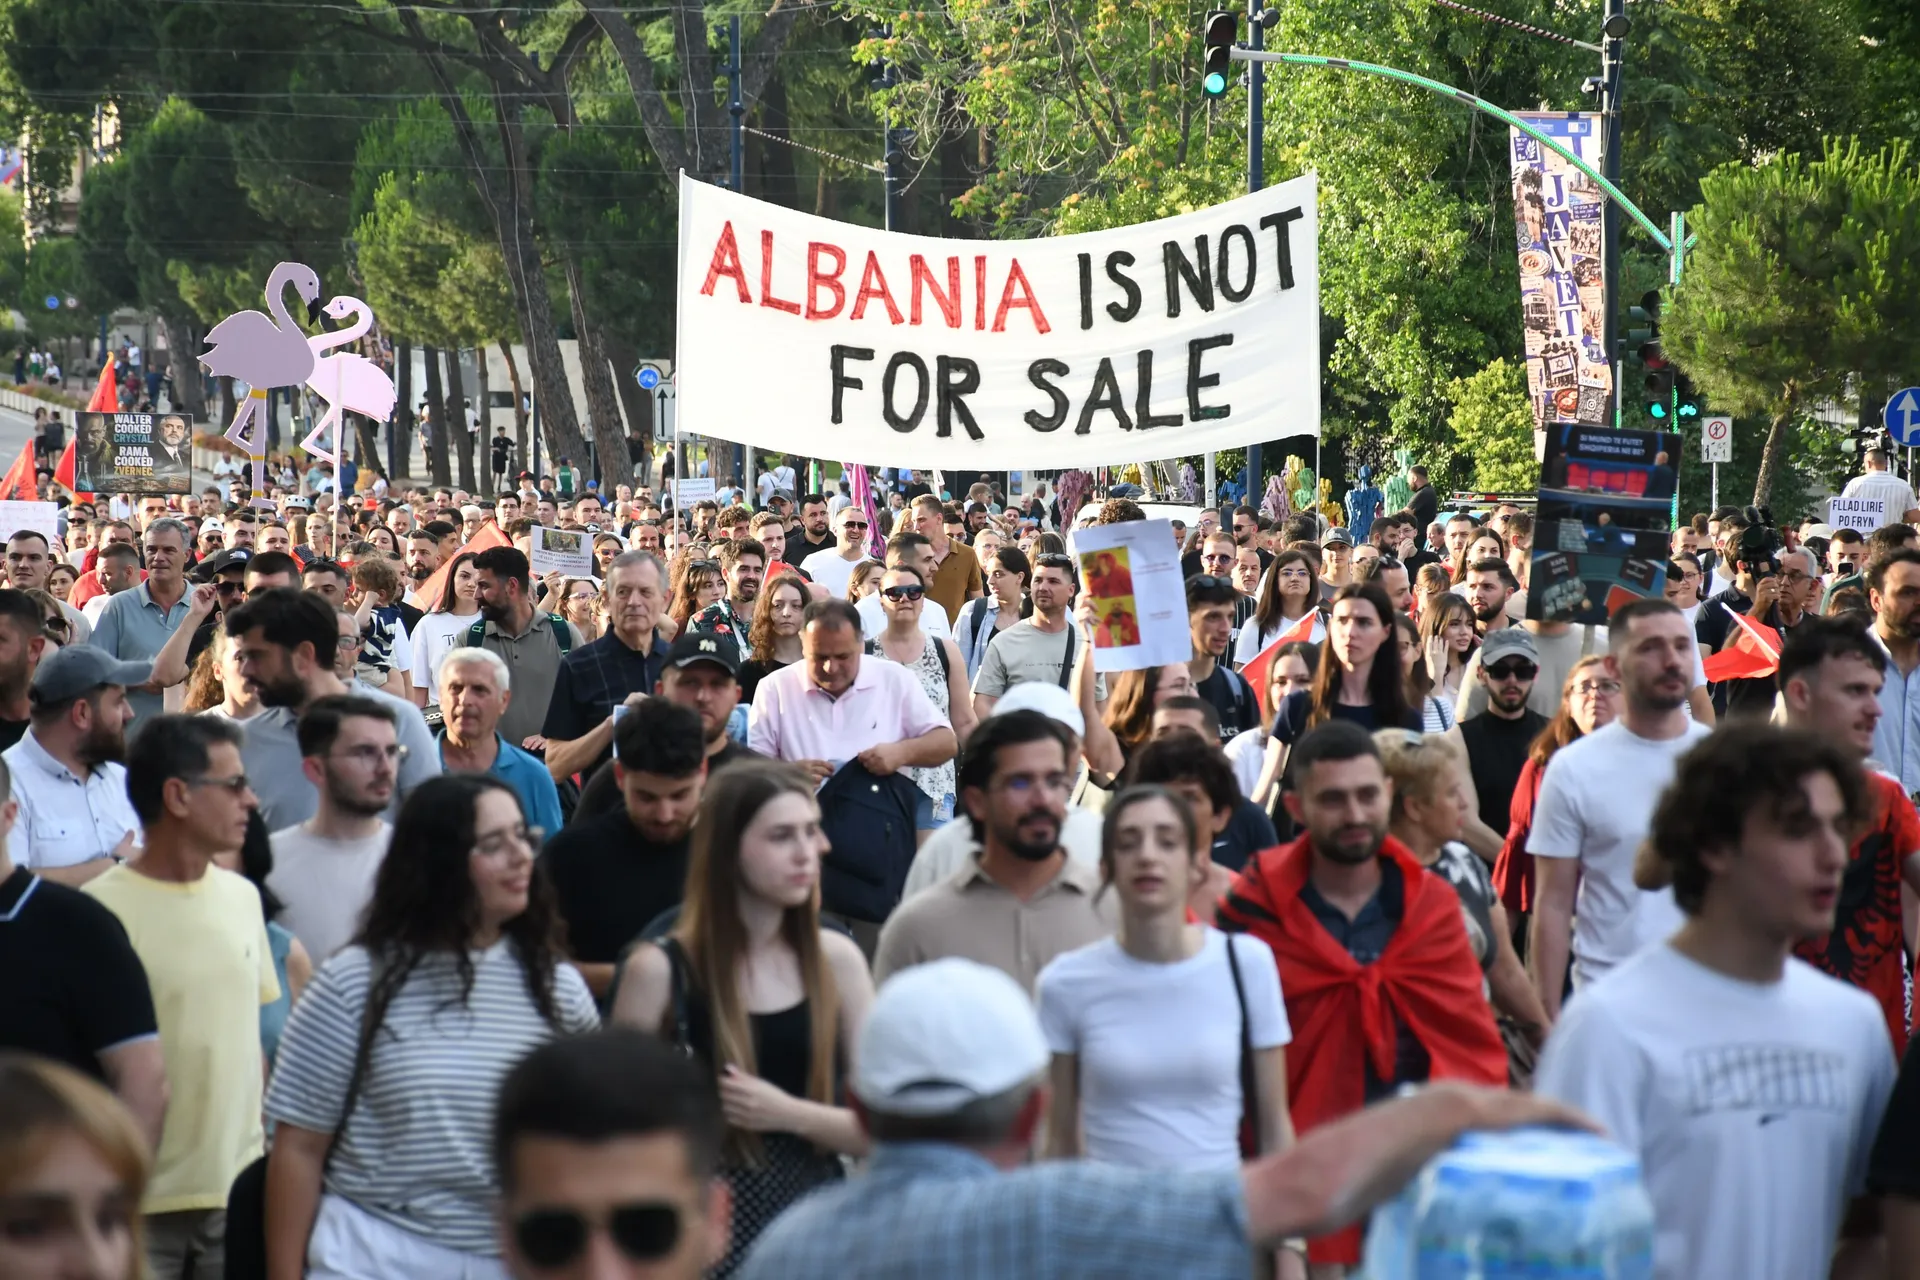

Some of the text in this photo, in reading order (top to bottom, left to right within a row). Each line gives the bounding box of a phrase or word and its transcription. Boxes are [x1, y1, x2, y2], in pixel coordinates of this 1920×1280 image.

[700, 206, 1304, 334] ALBANIA IS NOT
[830, 333, 1235, 441] FOR SALE
[114, 414, 152, 425] WALTER
[114, 423, 152, 434] COOKED
[113, 433, 155, 444] CRYSTAL.
[1588, 435, 1612, 444] MUND
[1622, 438, 1644, 446] FUTET
[119, 446, 149, 457] RAMA
[1578, 443, 1620, 453] SHQIPERIA
[114, 456, 154, 467] COOKED
[1832, 499, 1884, 513] FLLAD LIRIE
[1838, 515, 1875, 528] PO FRYN
